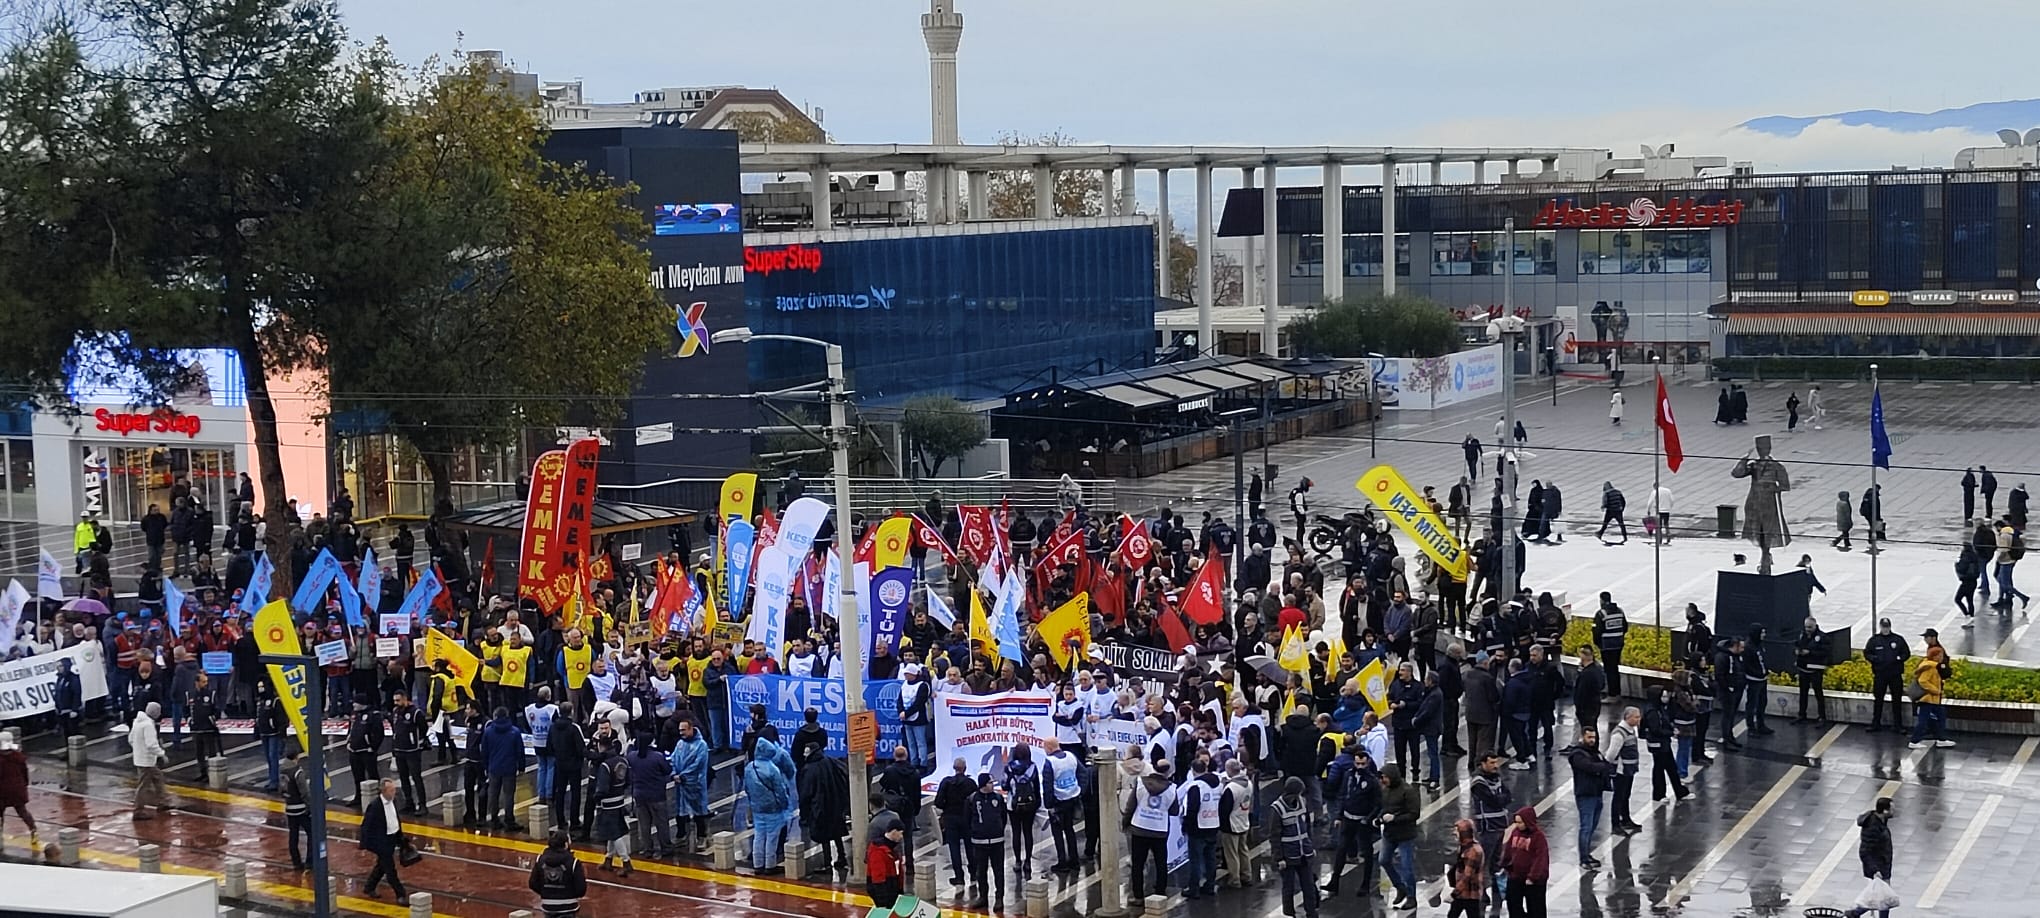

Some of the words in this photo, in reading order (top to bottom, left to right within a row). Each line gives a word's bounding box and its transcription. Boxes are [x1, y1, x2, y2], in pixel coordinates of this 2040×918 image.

[1531, 197, 1629, 227] Media
[1653, 196, 1745, 227] Markt
[743, 246, 823, 276] SuperStep
[648, 265, 665, 290] nt
[667, 262, 721, 292] Meydanı
[724, 265, 745, 284] AVM
[1981, 293, 2014, 301] KAHVE
[1178, 398, 1209, 413] STARBUCKS
[94, 408, 202, 438] SuperStep
[528, 484, 554, 582] EMEK
[763, 581, 785, 597] KESK
[734, 691, 770, 705] KESK
[965, 718, 991, 732] HALK
[992, 715, 1008, 729] İÇİN
[1009, 716, 1036, 732] BÜTÇE,
[956, 730, 1010, 747] DEMOKRATİK
